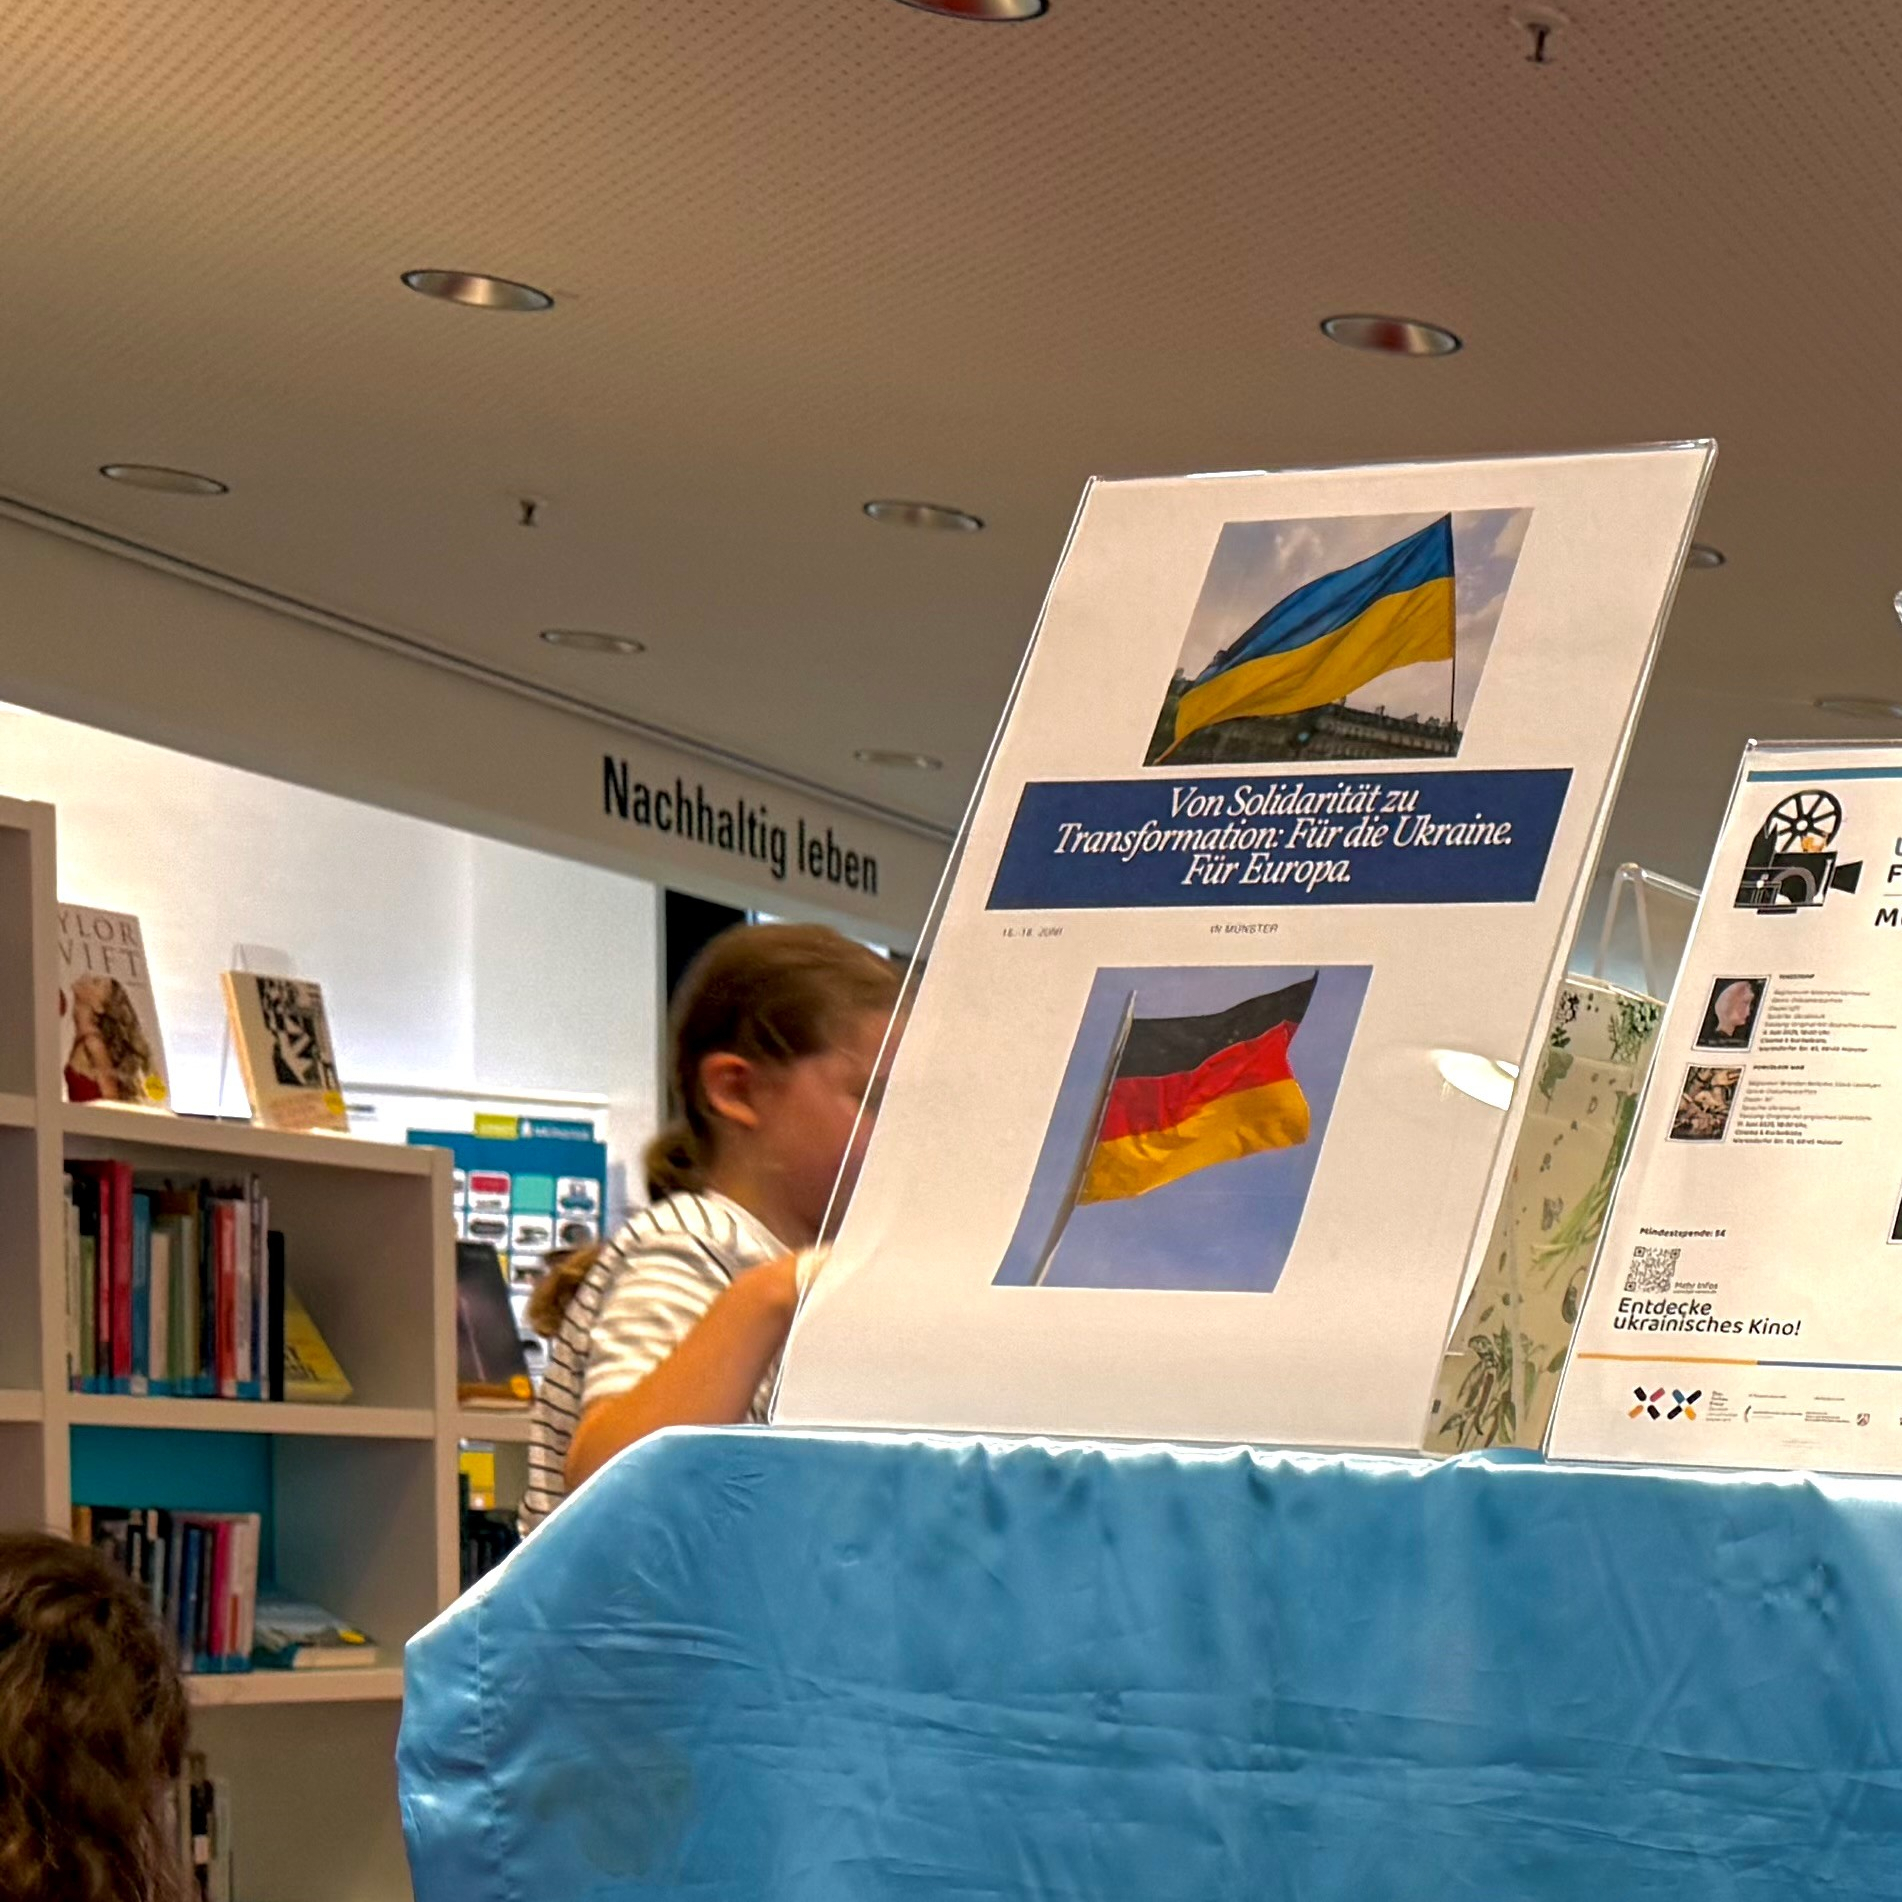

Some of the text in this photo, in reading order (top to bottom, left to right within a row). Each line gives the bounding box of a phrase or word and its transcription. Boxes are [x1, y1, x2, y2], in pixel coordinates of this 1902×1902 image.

[1170, 784, 1420, 818] Von Solidarität zu
[602, 754, 879, 896] Nachhaltig leben
[1052, 813, 1514, 862] Transformation: Für die Ukraine.
[1181, 851, 1352, 892] Für Europa.
[58, 910, 139, 947] YLOR
[1613, 1314, 1802, 1336] ukrainisches Kino!
[1617, 1297, 1713, 1316] Entdecke
